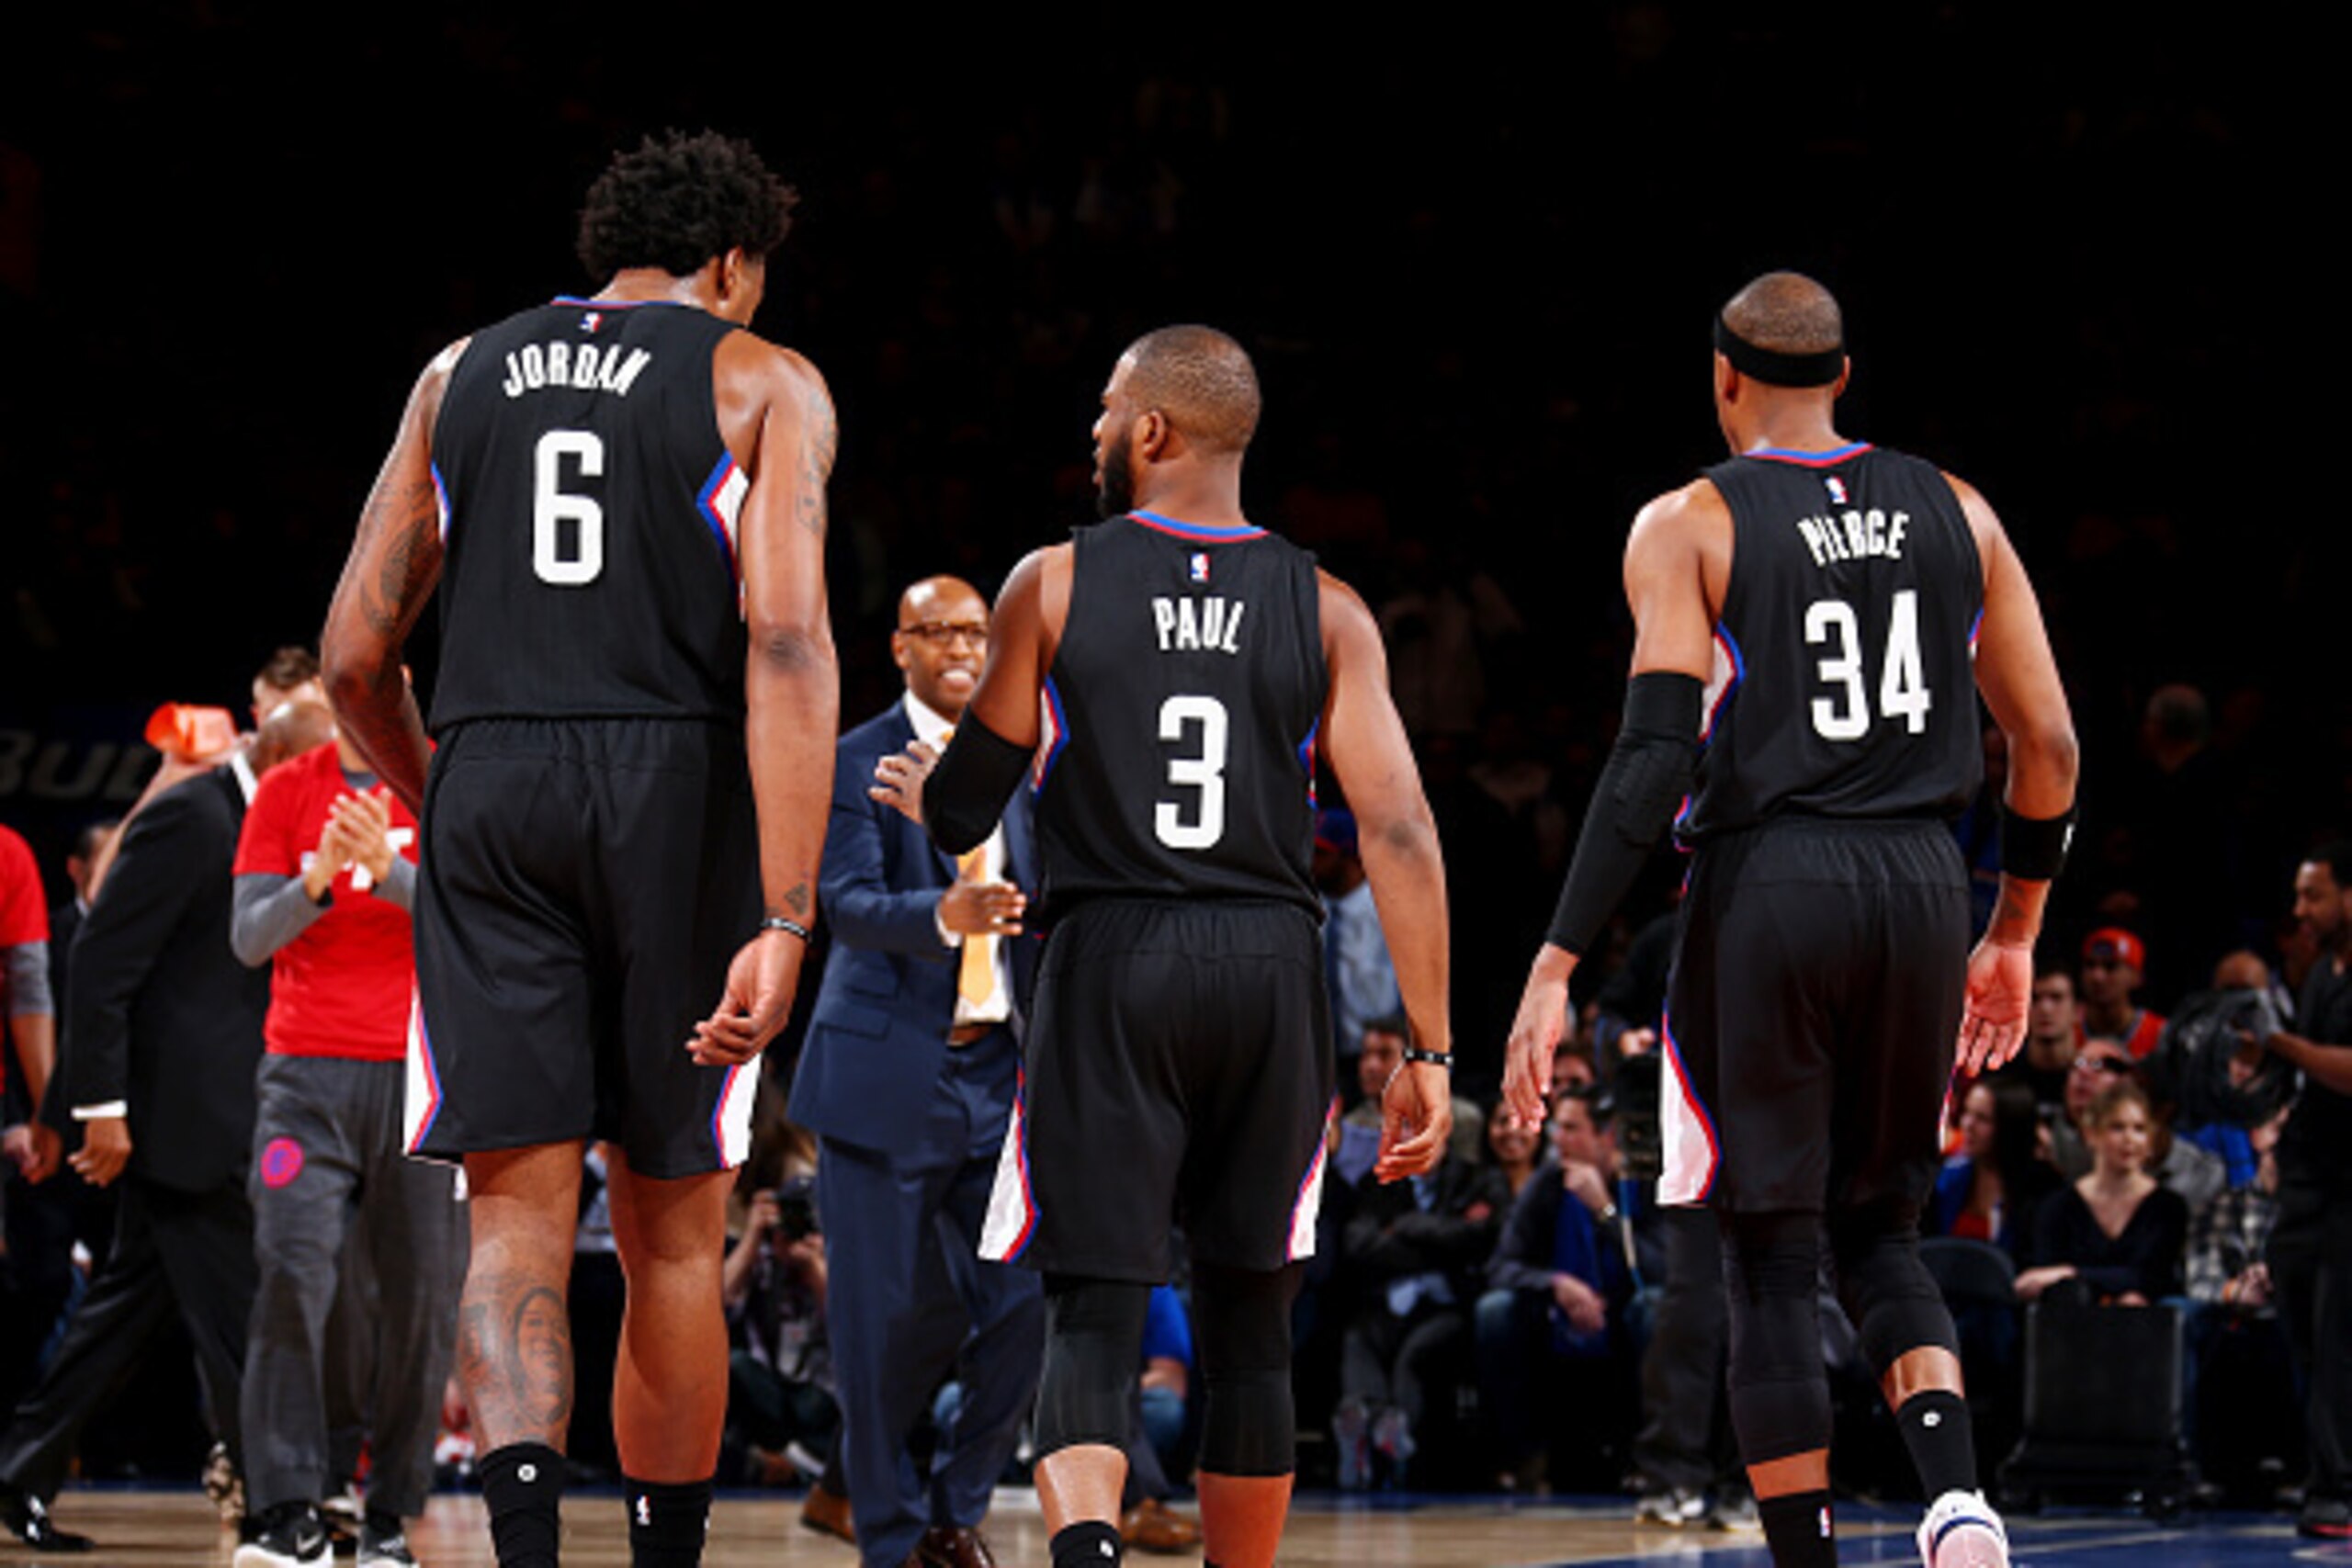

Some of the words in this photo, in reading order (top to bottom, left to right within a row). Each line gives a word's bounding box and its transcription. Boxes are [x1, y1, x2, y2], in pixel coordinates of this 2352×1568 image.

[503, 340, 651, 398] JORDAN
[533, 430, 604, 585] 6
[1797, 508, 1909, 567] PIERCE
[1152, 596, 1244, 654] PAUL
[1804, 590, 1931, 740] 34
[1155, 695, 1228, 849] 3
